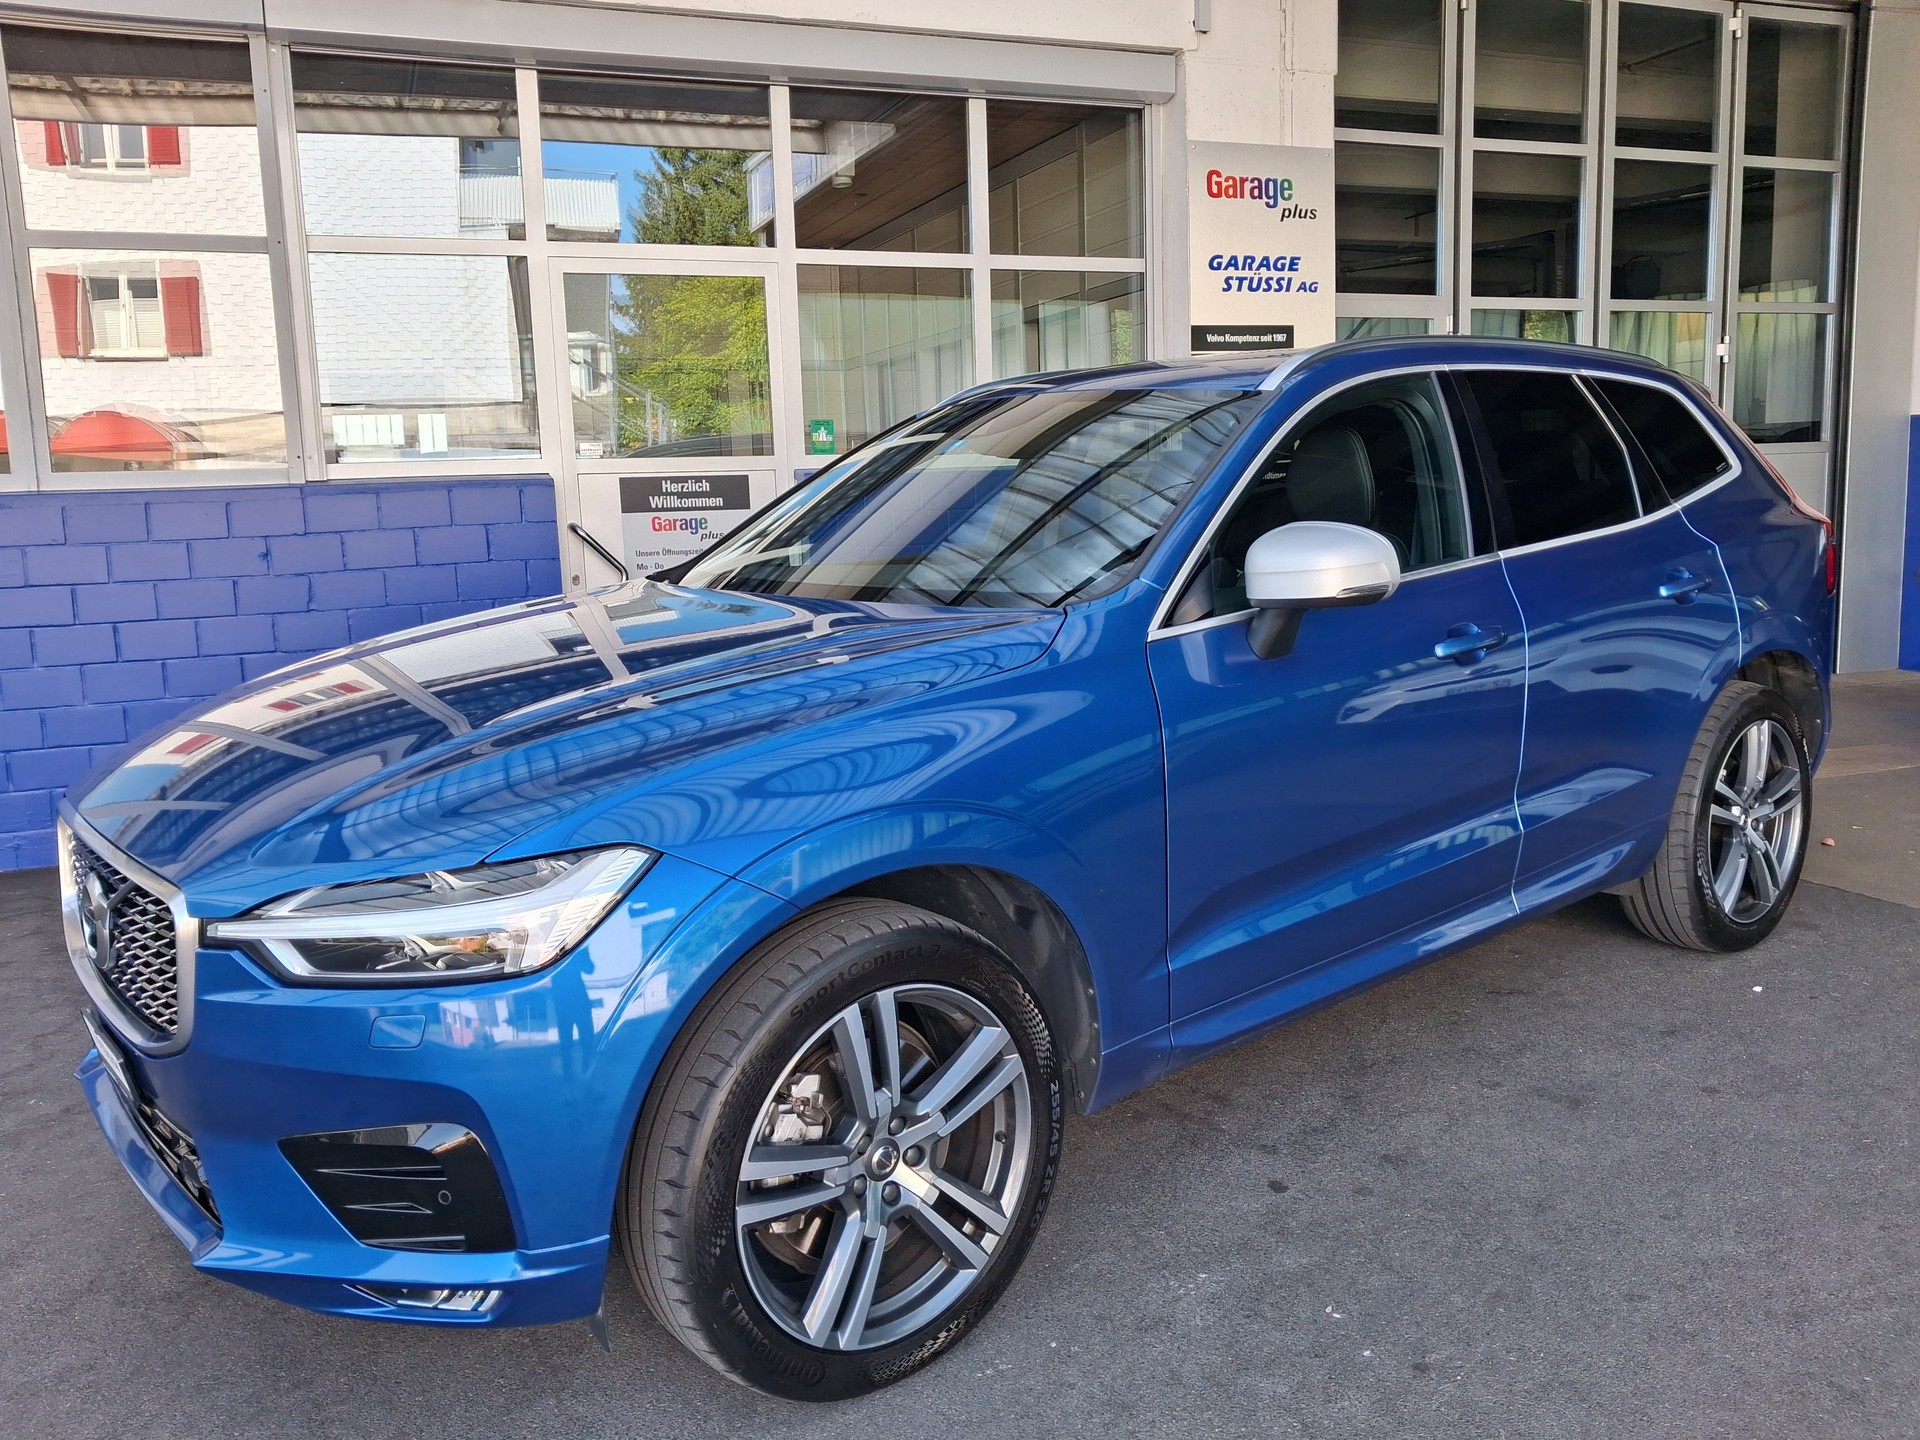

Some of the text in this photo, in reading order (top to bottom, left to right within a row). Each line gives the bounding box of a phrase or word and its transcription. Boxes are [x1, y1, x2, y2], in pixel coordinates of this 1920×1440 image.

[1206, 169, 1293, 209] Garage
[1280, 203, 1318, 222] plus
[1208, 254, 1301, 272] GARAGE
[1222, 272, 1319, 293] STÜSSI AG
[1206, 333, 1287, 344] Volvo Kompetenz seit 1967
[662, 480, 710, 492] Herzlich
[649, 495, 723, 508] Willkommen
[651, 516, 708, 535] Garage
[700, 530, 724, 541] plus
[636, 563, 649, 571] Mo
[654, 562, 664, 570] Do
[789, 943, 925, 1023] SportContact
[1050, 1079, 1061, 1157] 255/45
[1040, 1164, 1056, 1194] ZR
